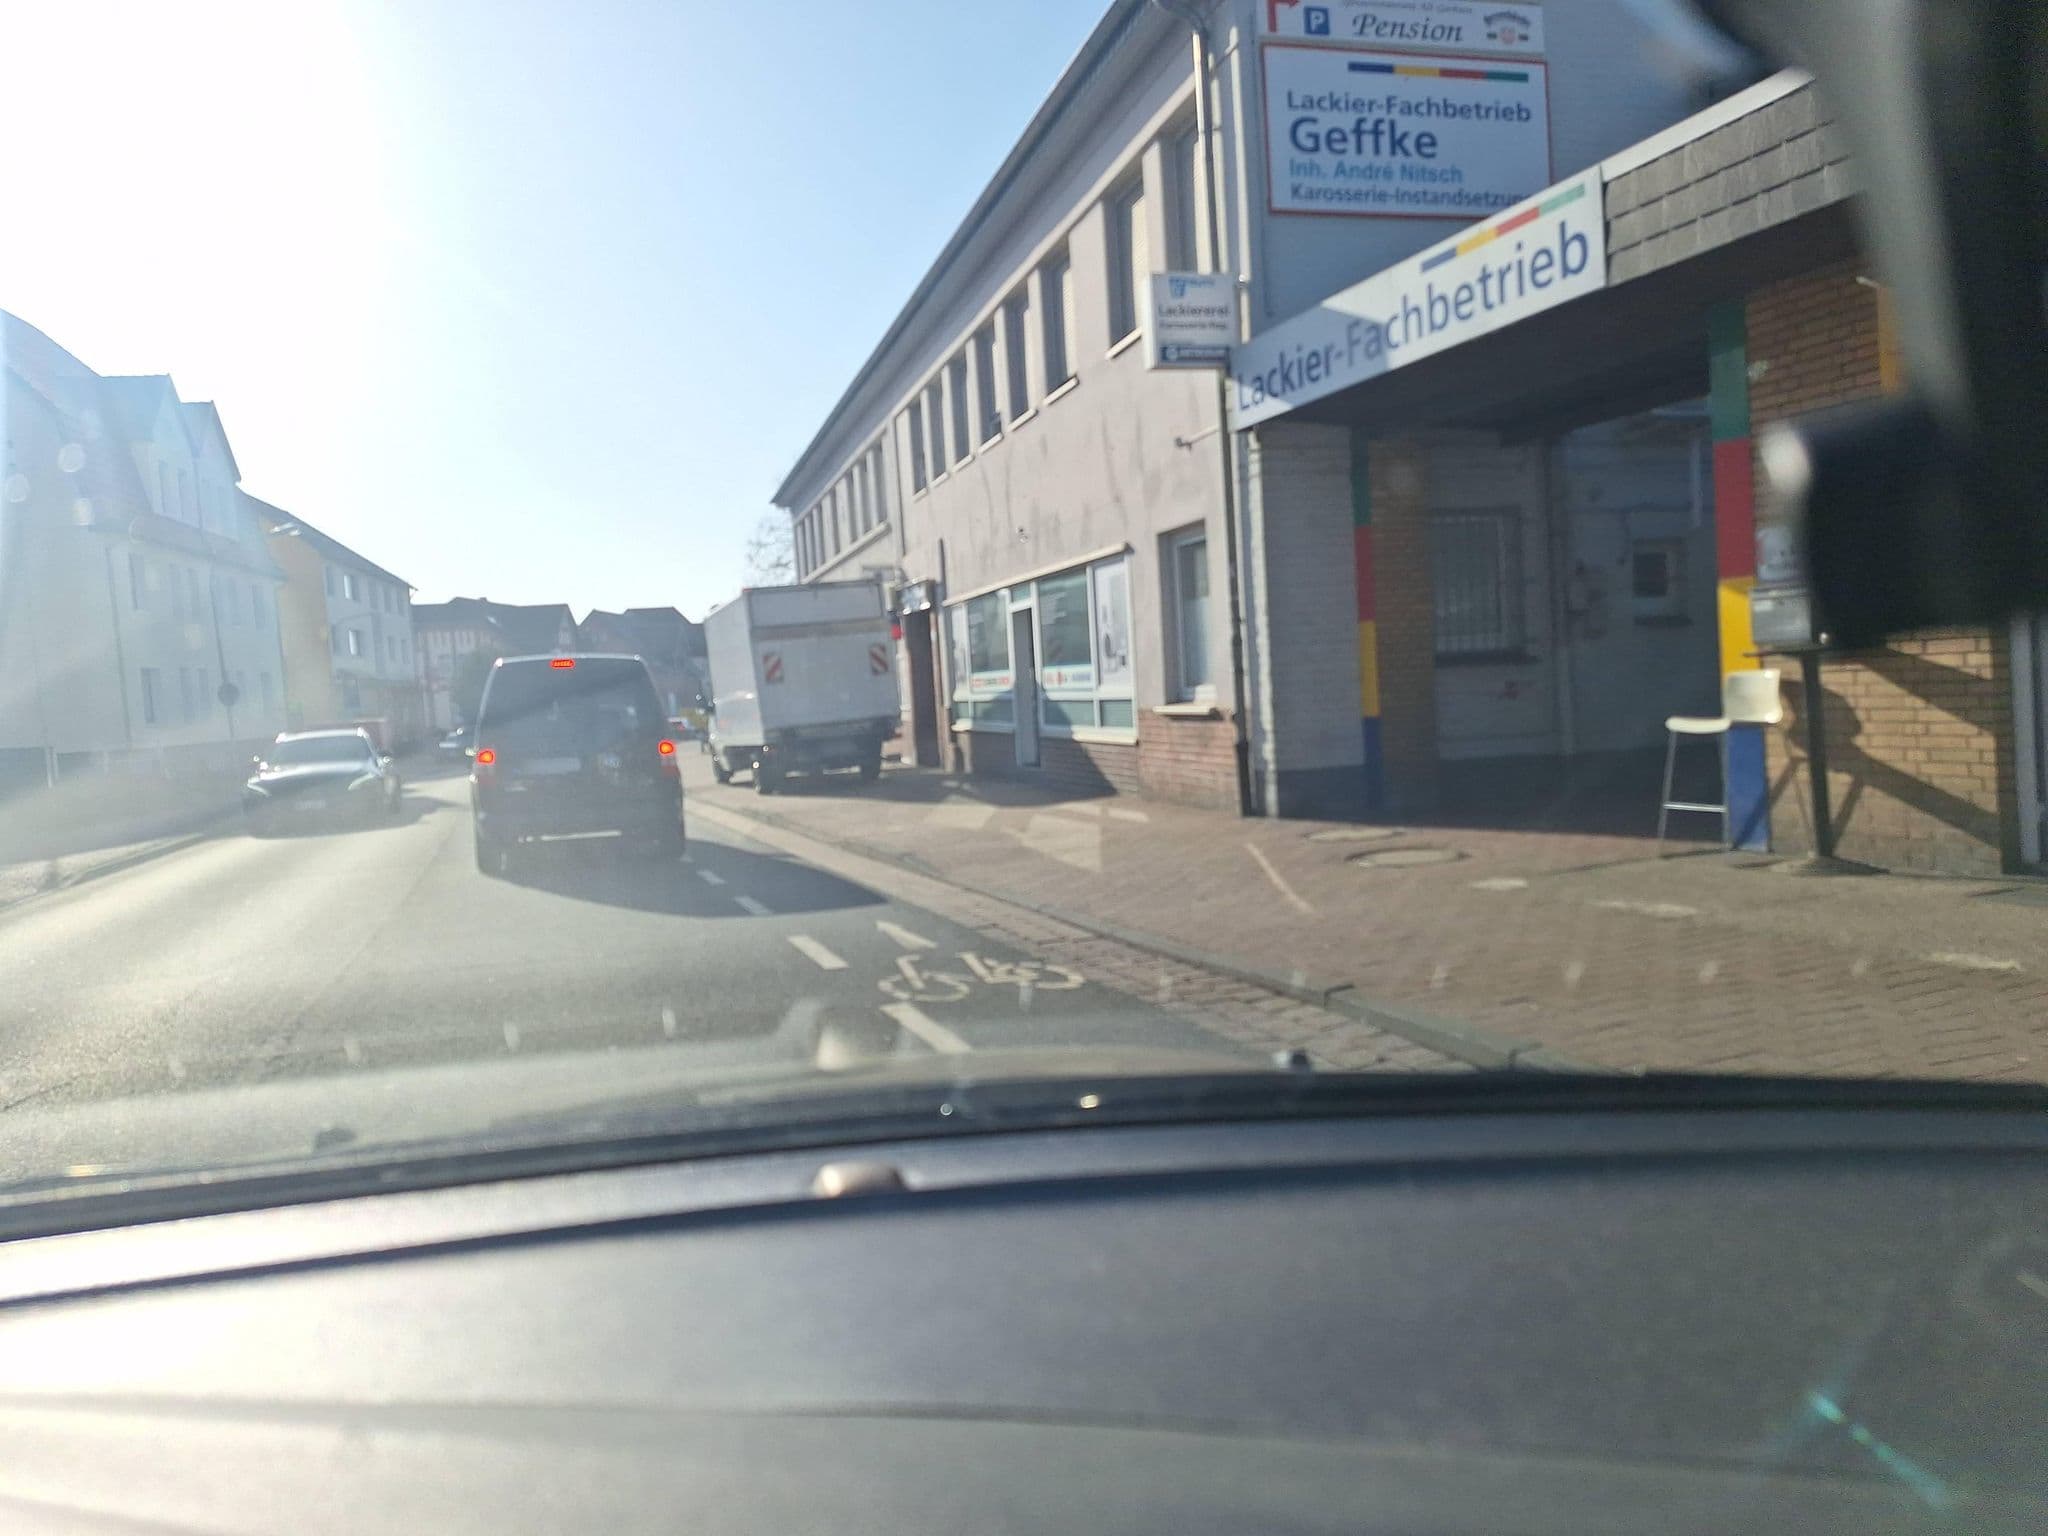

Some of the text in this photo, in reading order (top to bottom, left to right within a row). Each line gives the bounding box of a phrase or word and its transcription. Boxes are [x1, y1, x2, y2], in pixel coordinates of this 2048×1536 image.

[1351, 12, 1464, 42] Pension
[1286, 90, 1532, 123] Lackier-Fachbetrieb
[1288, 116, 1438, 159] Geffke
[1288, 159, 1463, 184] Inh. André Nitsch
[1238, 219, 1589, 412] Lackier-Fachbetrieb
